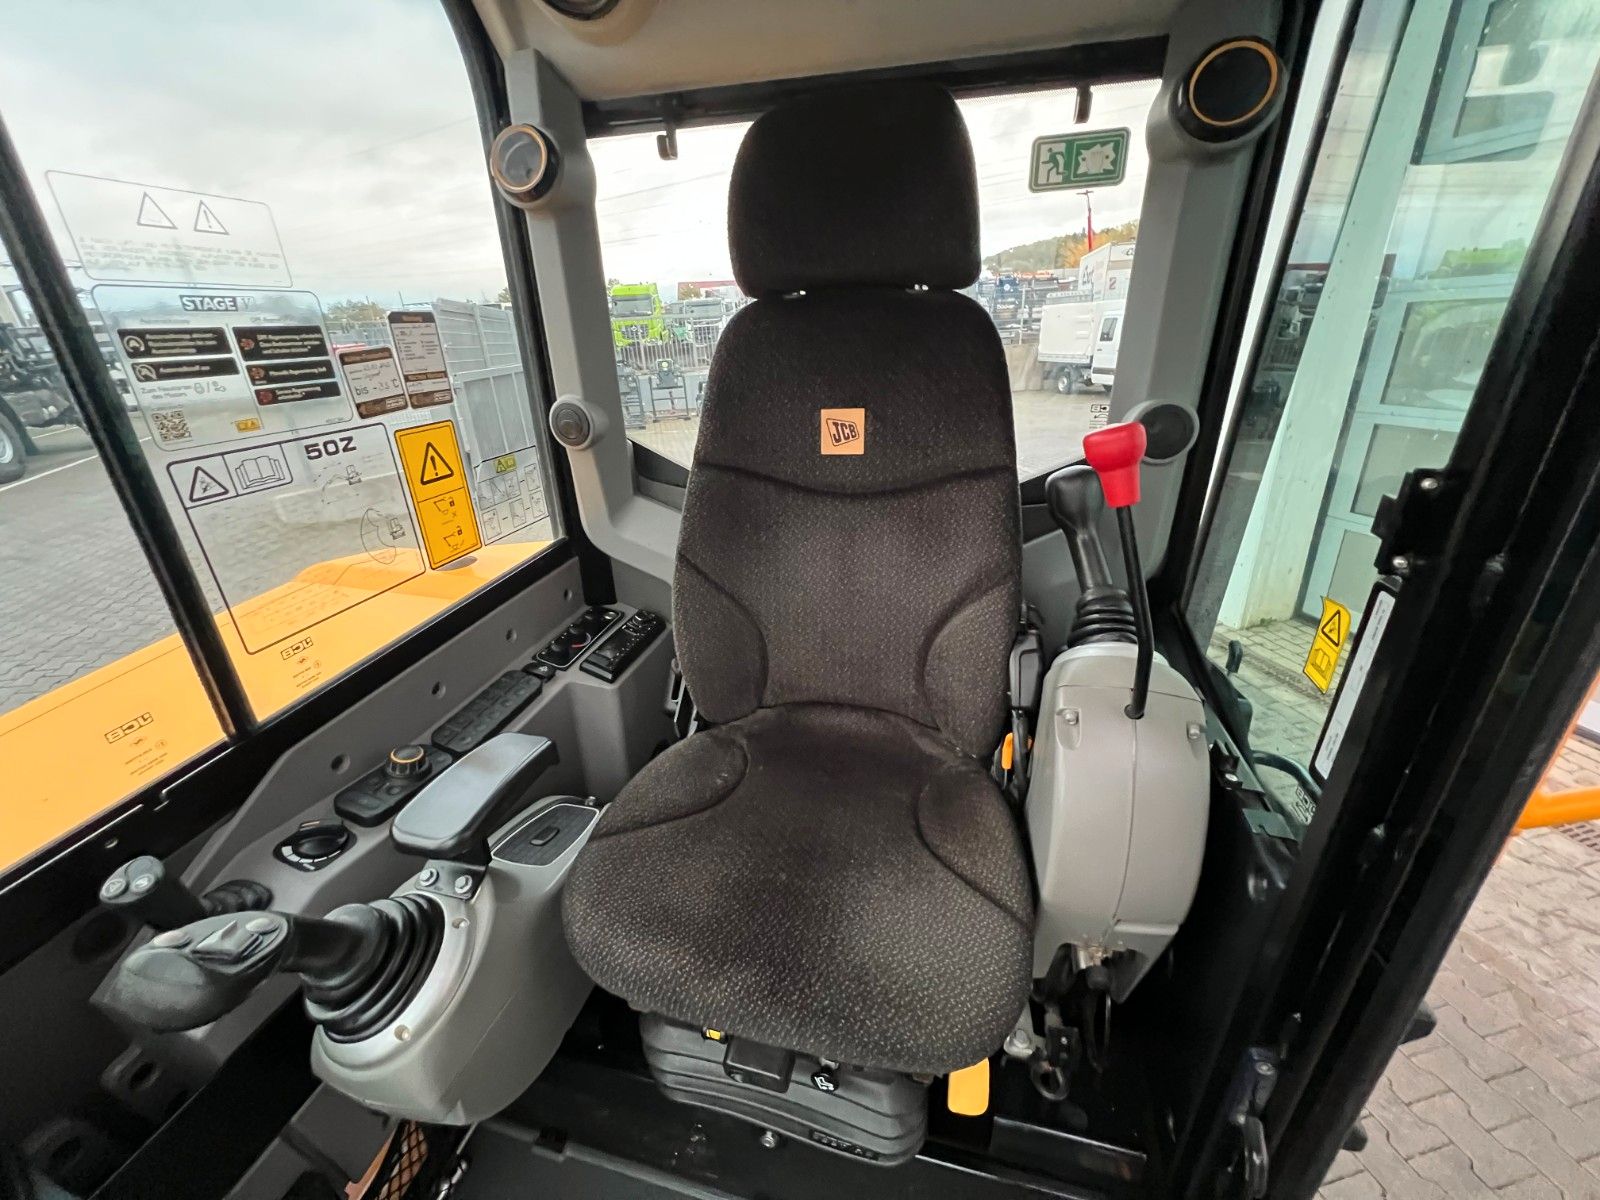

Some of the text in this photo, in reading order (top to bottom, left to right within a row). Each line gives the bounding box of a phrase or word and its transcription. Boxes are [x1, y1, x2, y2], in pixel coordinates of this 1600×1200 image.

[181, 296, 237, 311] STAGE
[832, 421, 857, 444] JCB
[303, 436, 357, 460] 50Z
